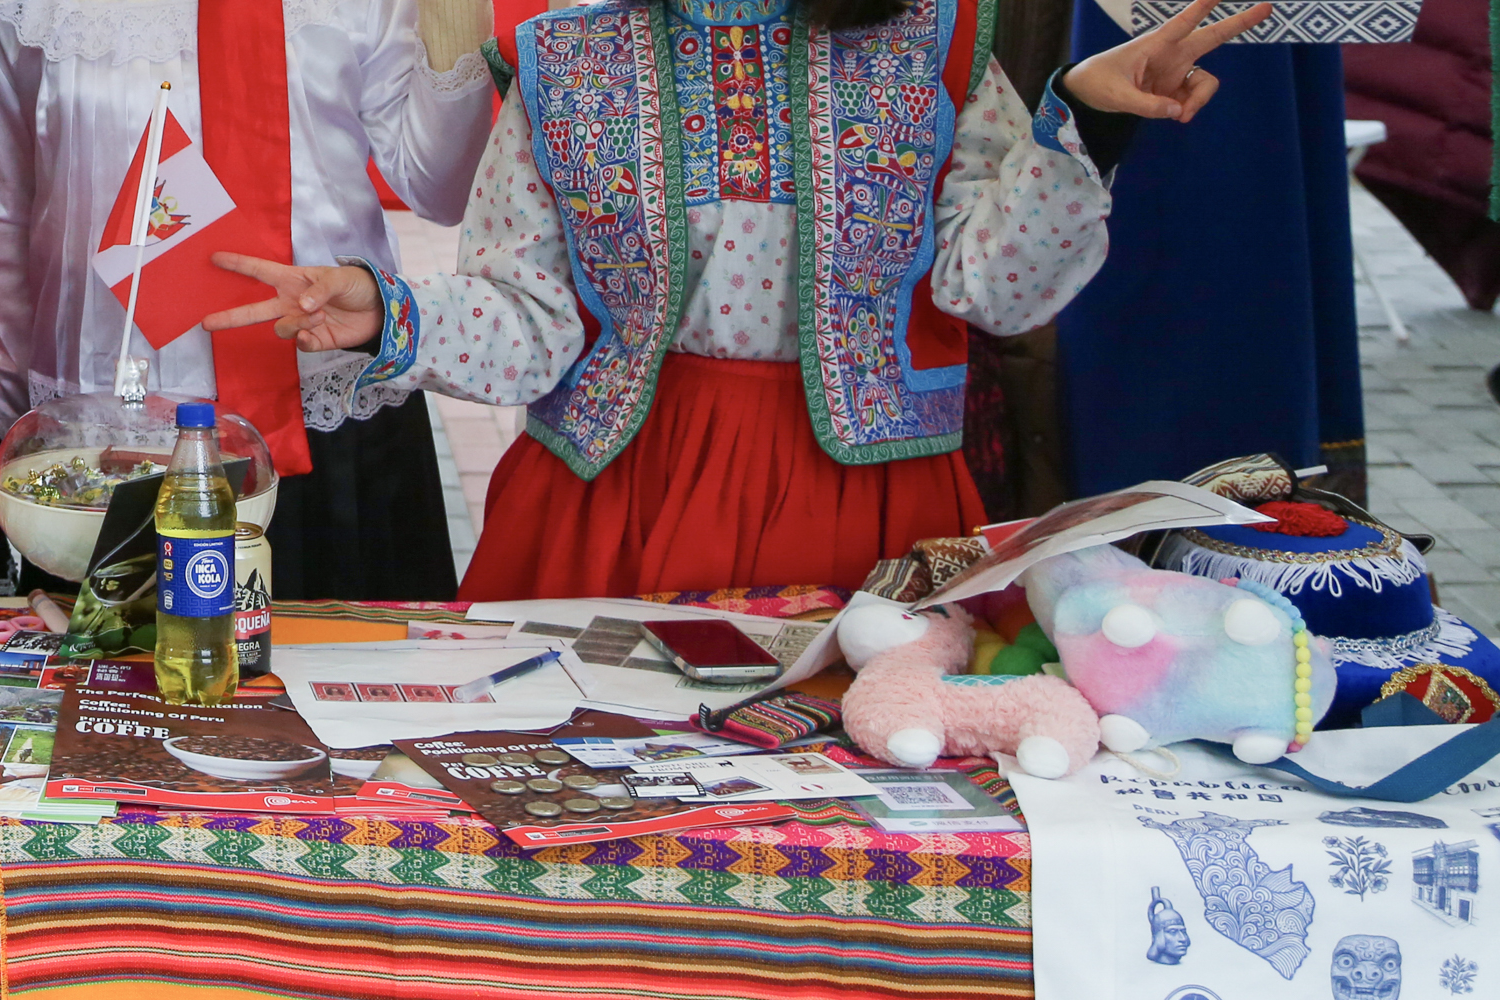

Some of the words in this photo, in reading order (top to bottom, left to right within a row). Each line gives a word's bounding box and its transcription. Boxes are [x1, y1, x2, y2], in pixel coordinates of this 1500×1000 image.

[195, 563, 217, 574] INCA
[198, 573, 222, 585] KOLA
[238, 641, 260, 651] EGRA
[107, 690, 162, 703] Perfect
[79, 699, 131, 708] Coffee:
[78, 704, 165, 718] Positioning
[167, 712, 188, 720] Of
[190, 714, 225, 722] Peru
[79, 715, 140, 725] Peruvian
[75, 720, 170, 739] COFFE
[413, 741, 466, 749] Coffee:
[420, 745, 508, 755] Positioning
[507, 743, 529, 752] Of
